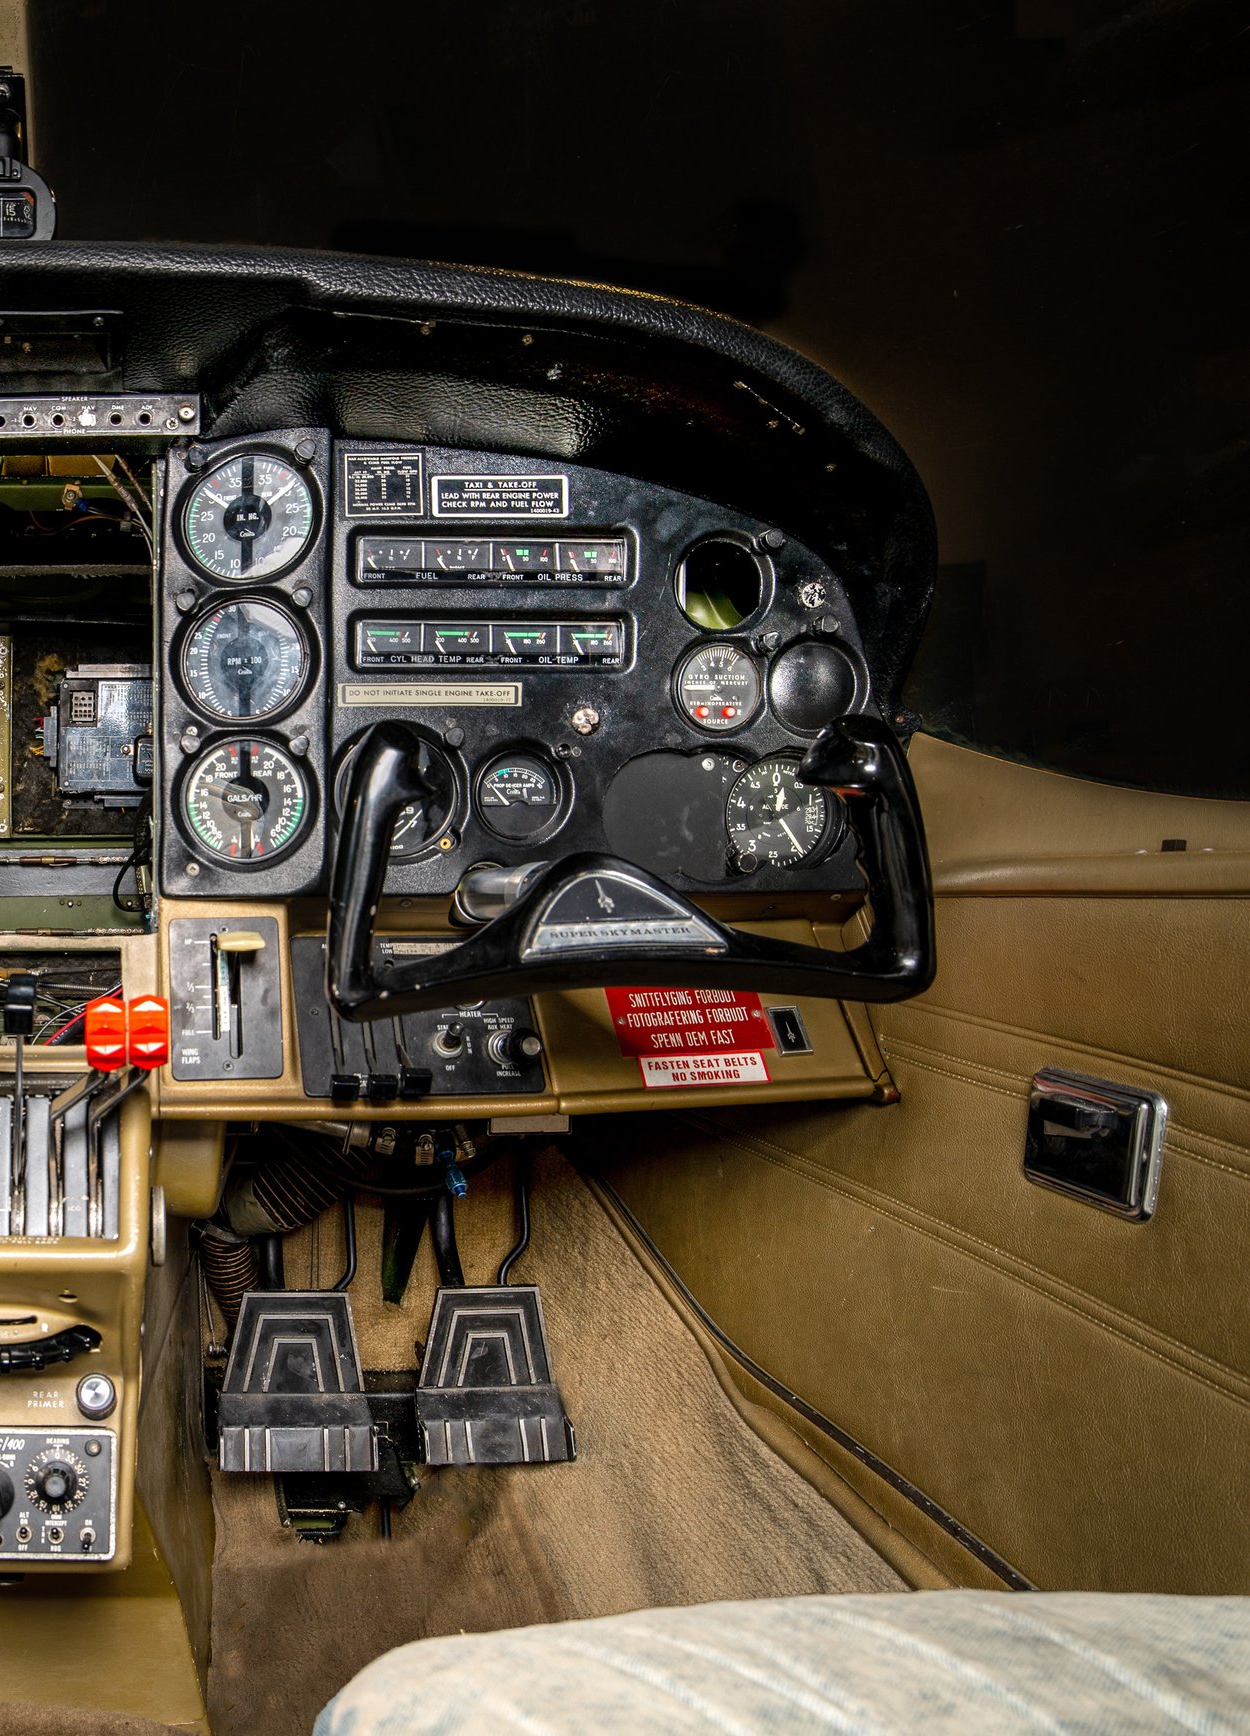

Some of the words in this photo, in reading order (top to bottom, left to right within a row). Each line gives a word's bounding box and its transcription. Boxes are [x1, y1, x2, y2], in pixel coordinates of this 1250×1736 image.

[229, 477, 242, 488] 35
[464, 481, 483, 489] TAXI
[487, 481, 494, 489] &
[498, 481, 537, 489] TAKE-OFF
[441, 500, 468, 508] CHECK
[470, 500, 487, 508] RPM
[489, 500, 507, 508] AND
[510, 500, 529, 508] FUEL
[532, 500, 554, 508] FLOW
[200, 510, 214, 522] 25
[248, 512, 259, 520] HG.
[202, 533, 216, 544] 20
[415, 572, 438, 580] FUEL
[537, 573, 552, 581] OIL
[555, 573, 584, 581] PRESS
[227, 658, 242, 666] RPM
[250, 656, 262, 664] 100
[390, 655, 408, 663] CYL
[411, 655, 435, 663] HEAD
[438, 655, 462, 663] TEMP
[538, 656, 552, 664] OIL
[556, 656, 579, 664] TEMP
[214, 771, 239, 779] FRONT
[772, 772, 781, 786] 0
[227, 793, 263, 802] GALS/HR
[737, 796, 746, 809] 4
[748, 839, 757, 852] 3
[549, 930, 598, 939] SUPER
[600, 927, 691, 937] SKYMASTER
[628, 990, 692, 1008] SNITTFLYGING
[695, 990, 736, 1004] FORBUDT
[626, 1009, 704, 1028] FOTOGRAFERING
[705, 1006, 749, 1023] FORBUDT
[650, 1032, 684, 1049] SPENN
[685, 1031, 709, 1047] DEM
[710, 1029, 736, 1045] FAST
[181, 1056, 201, 1065] FLAPS
[647, 1059, 690, 1071] FASTEN
[692, 1058, 720, 1069] SEAT
[724, 1056, 758, 1067] BELTS
[496, 1070, 521, 1078] INCREASE
[671, 1072, 687, 1082] NO
[690, 1069, 741, 1081] SMOKING
[33, 1391, 59, 1399] REAR
[27, 1400, 64, 1409] PRIMER
